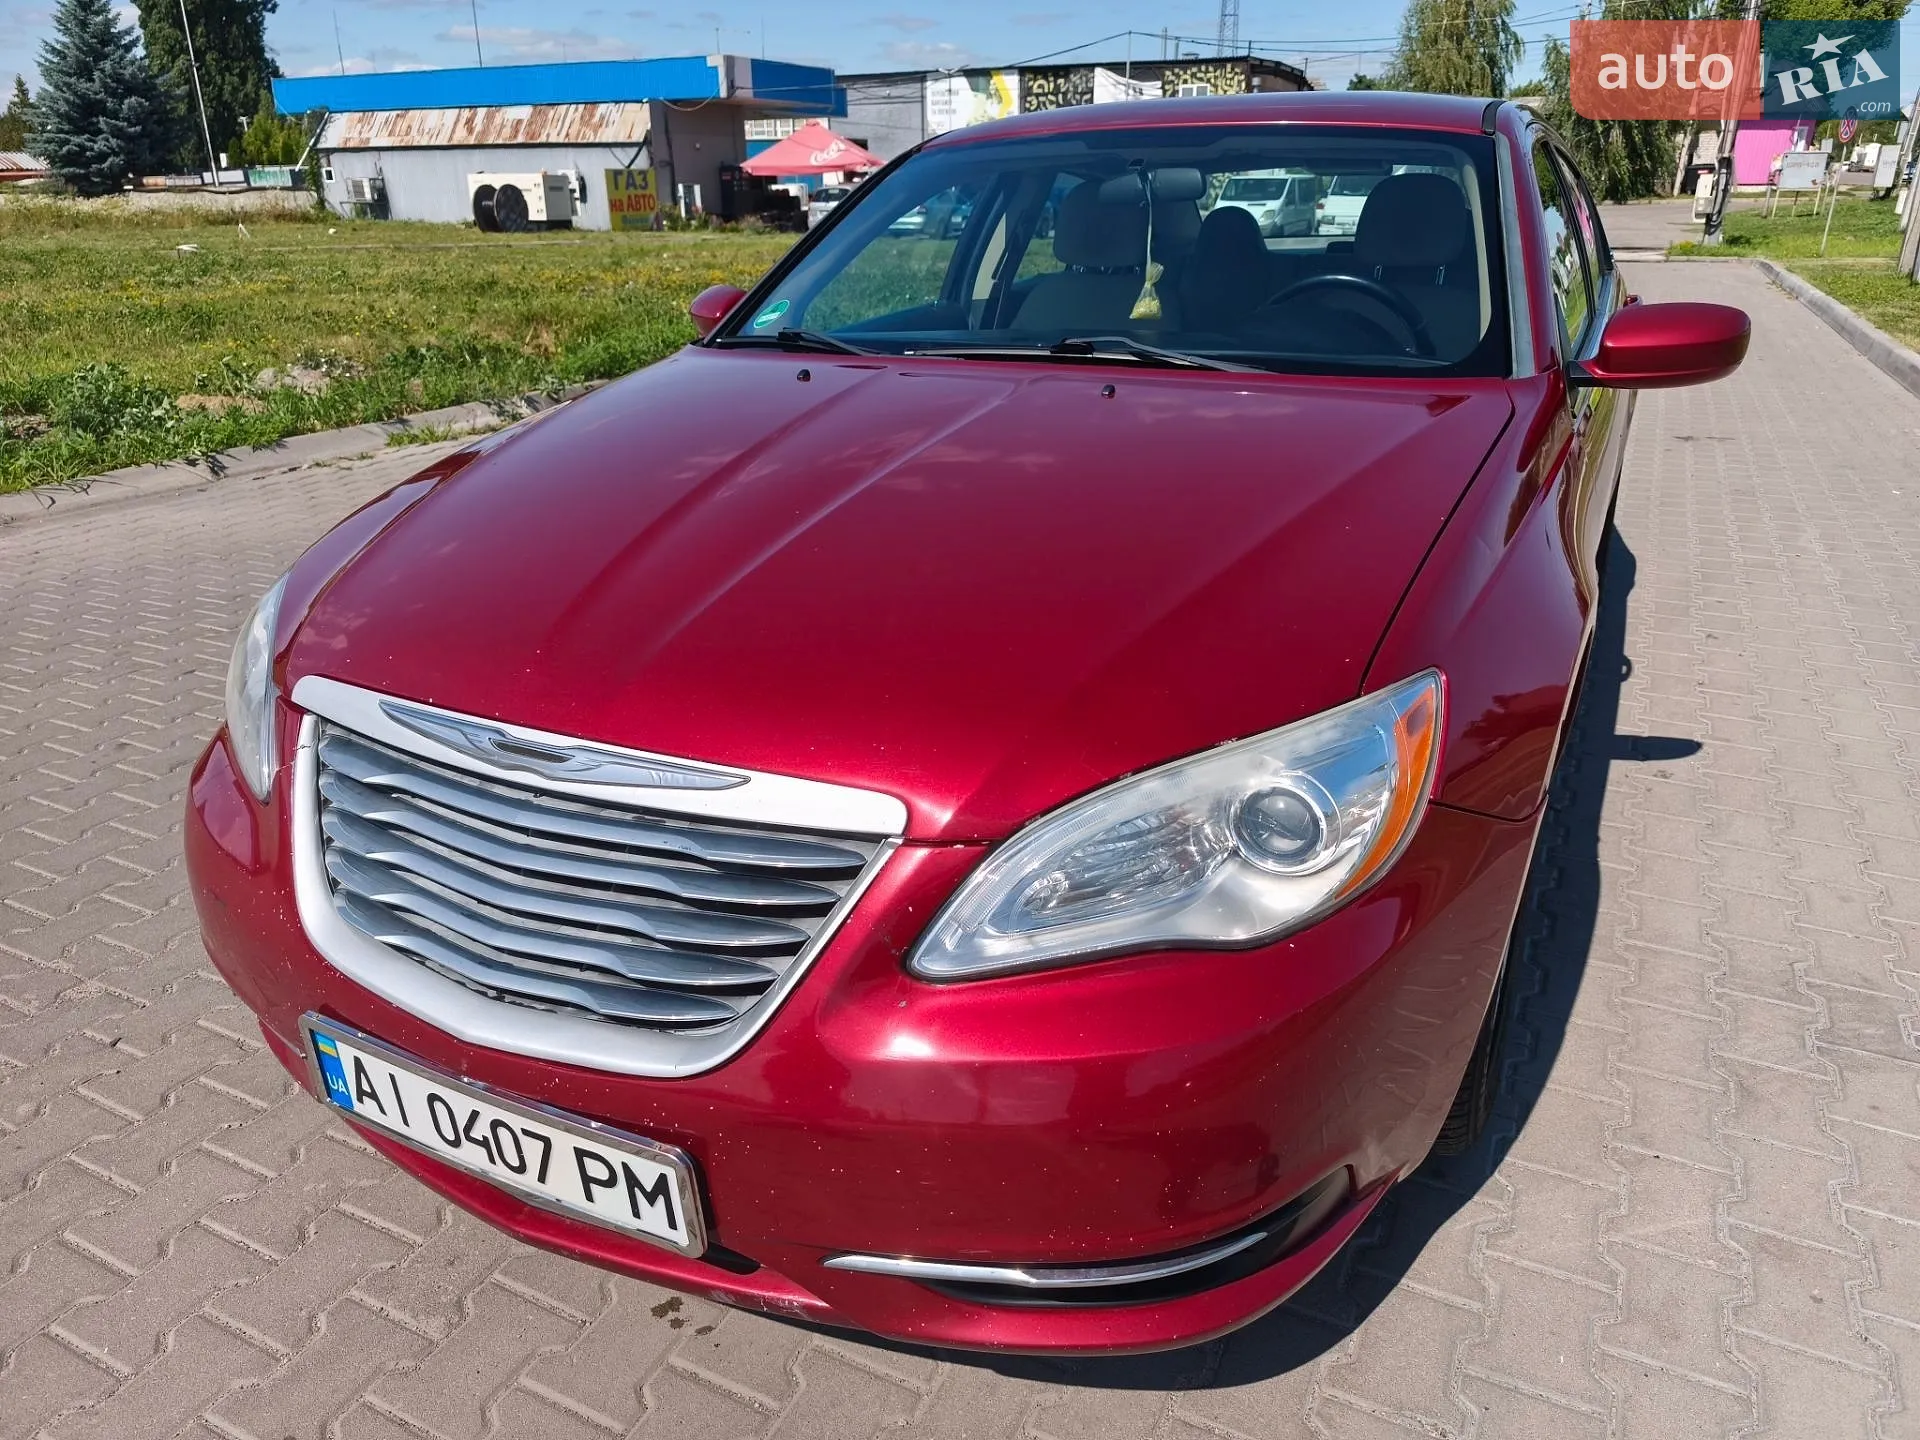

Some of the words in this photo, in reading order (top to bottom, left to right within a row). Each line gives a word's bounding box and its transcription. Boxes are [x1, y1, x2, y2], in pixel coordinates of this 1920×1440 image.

[613, 170, 649, 190] ГАЗ
[626, 194, 656, 212] АВТО
[326, 1073, 349, 1096] UA
[352, 1055, 410, 1128] AI
[426, 1092, 553, 1185] 0407
[573, 1146, 678, 1231] PM
